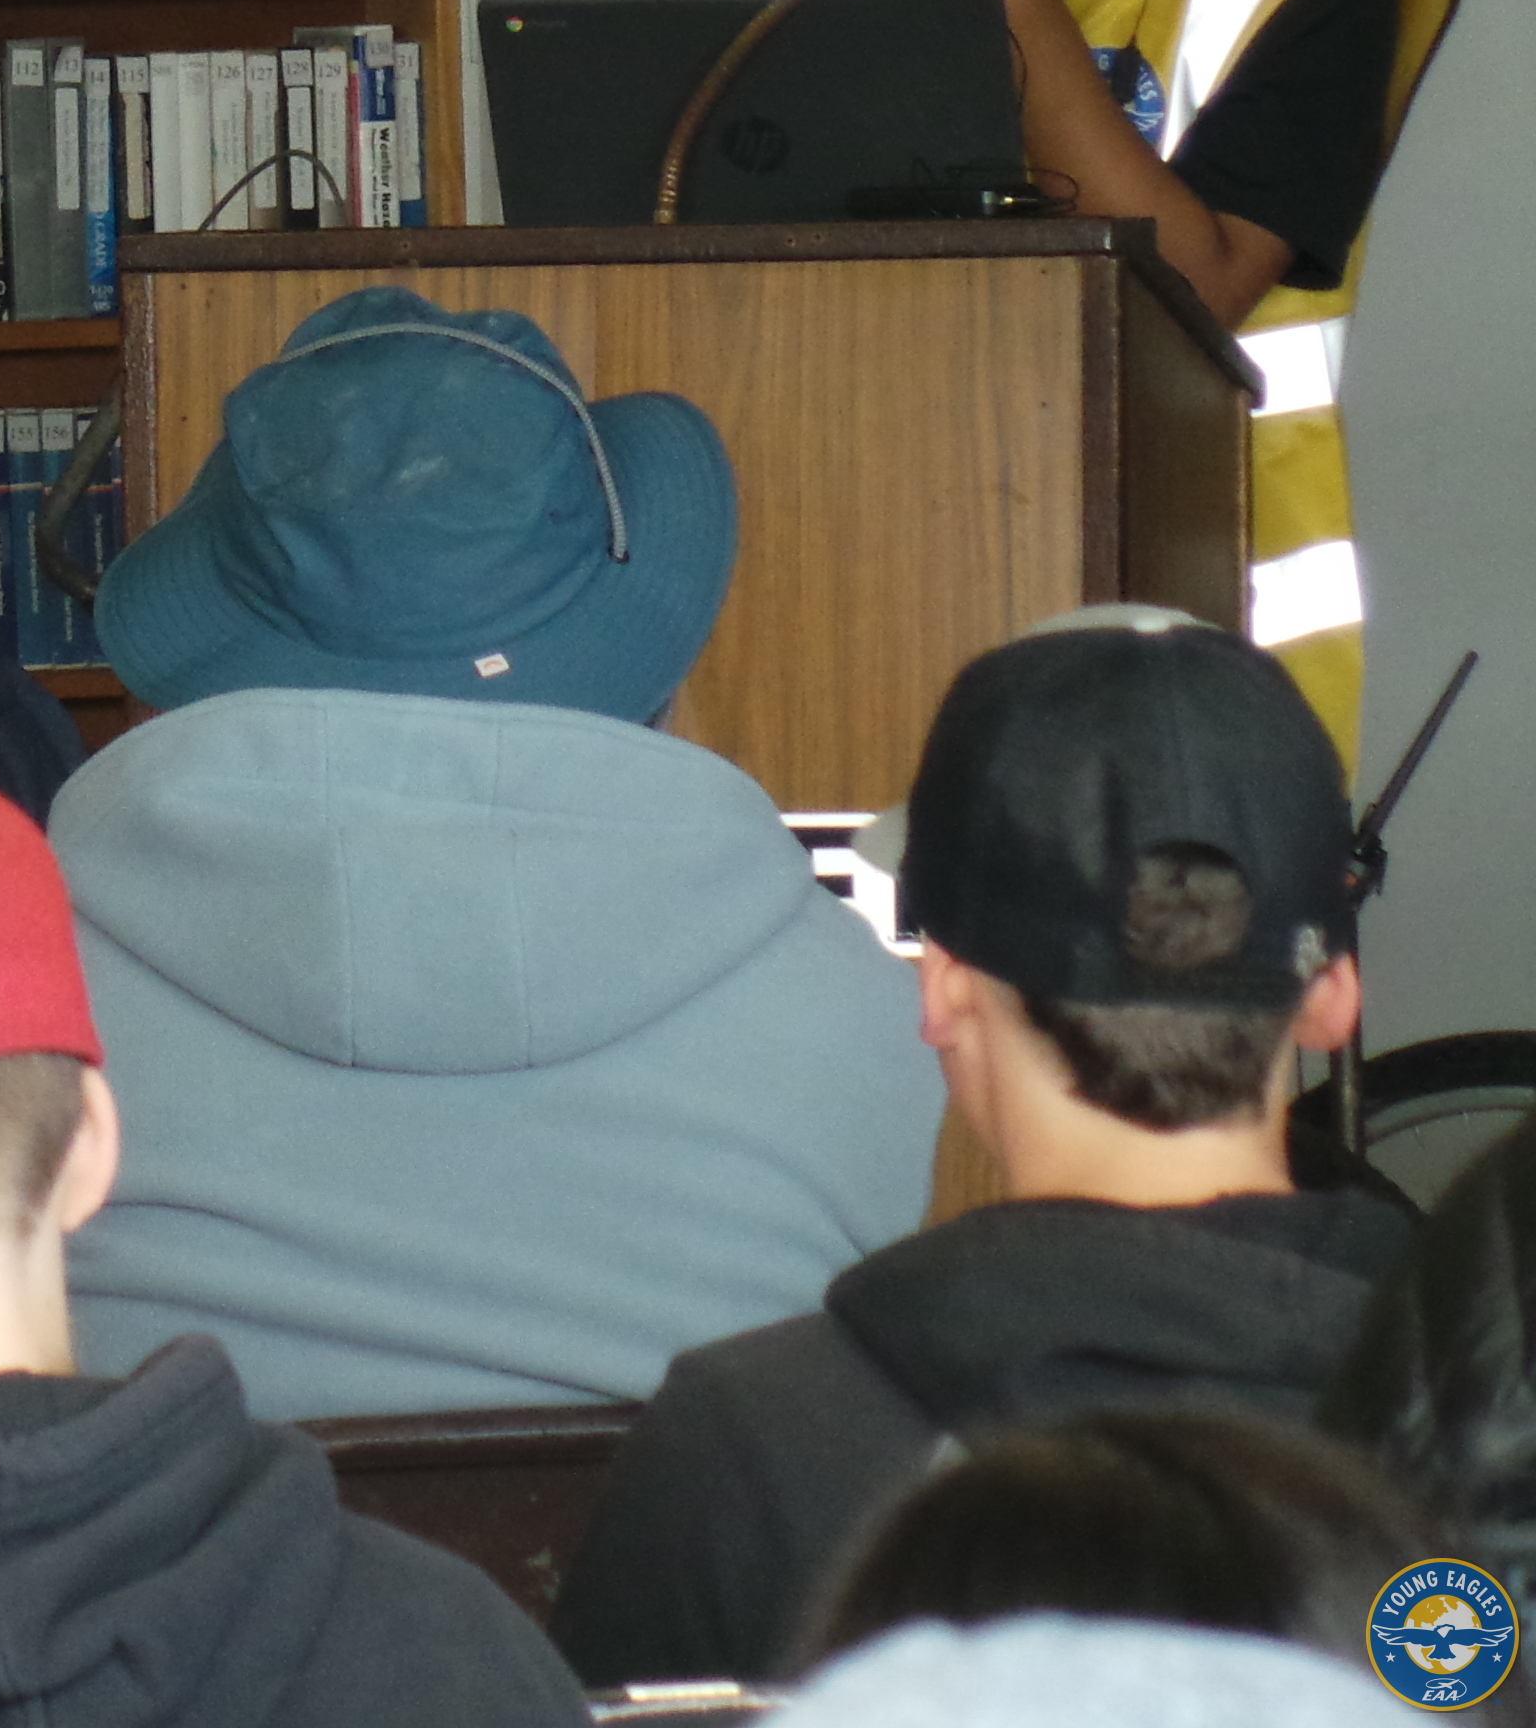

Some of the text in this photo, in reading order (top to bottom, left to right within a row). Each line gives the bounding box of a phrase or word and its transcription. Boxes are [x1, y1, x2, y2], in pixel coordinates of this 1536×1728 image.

[16, 62, 40, 76] 112
[217, 65, 241, 80] 126
[250, 67, 274, 81] 127
[285, 61, 310, 75] 128
[318, 64, 343, 78] 129
[378, 126, 391, 188] Weather
[43, 426, 69, 441] 156
